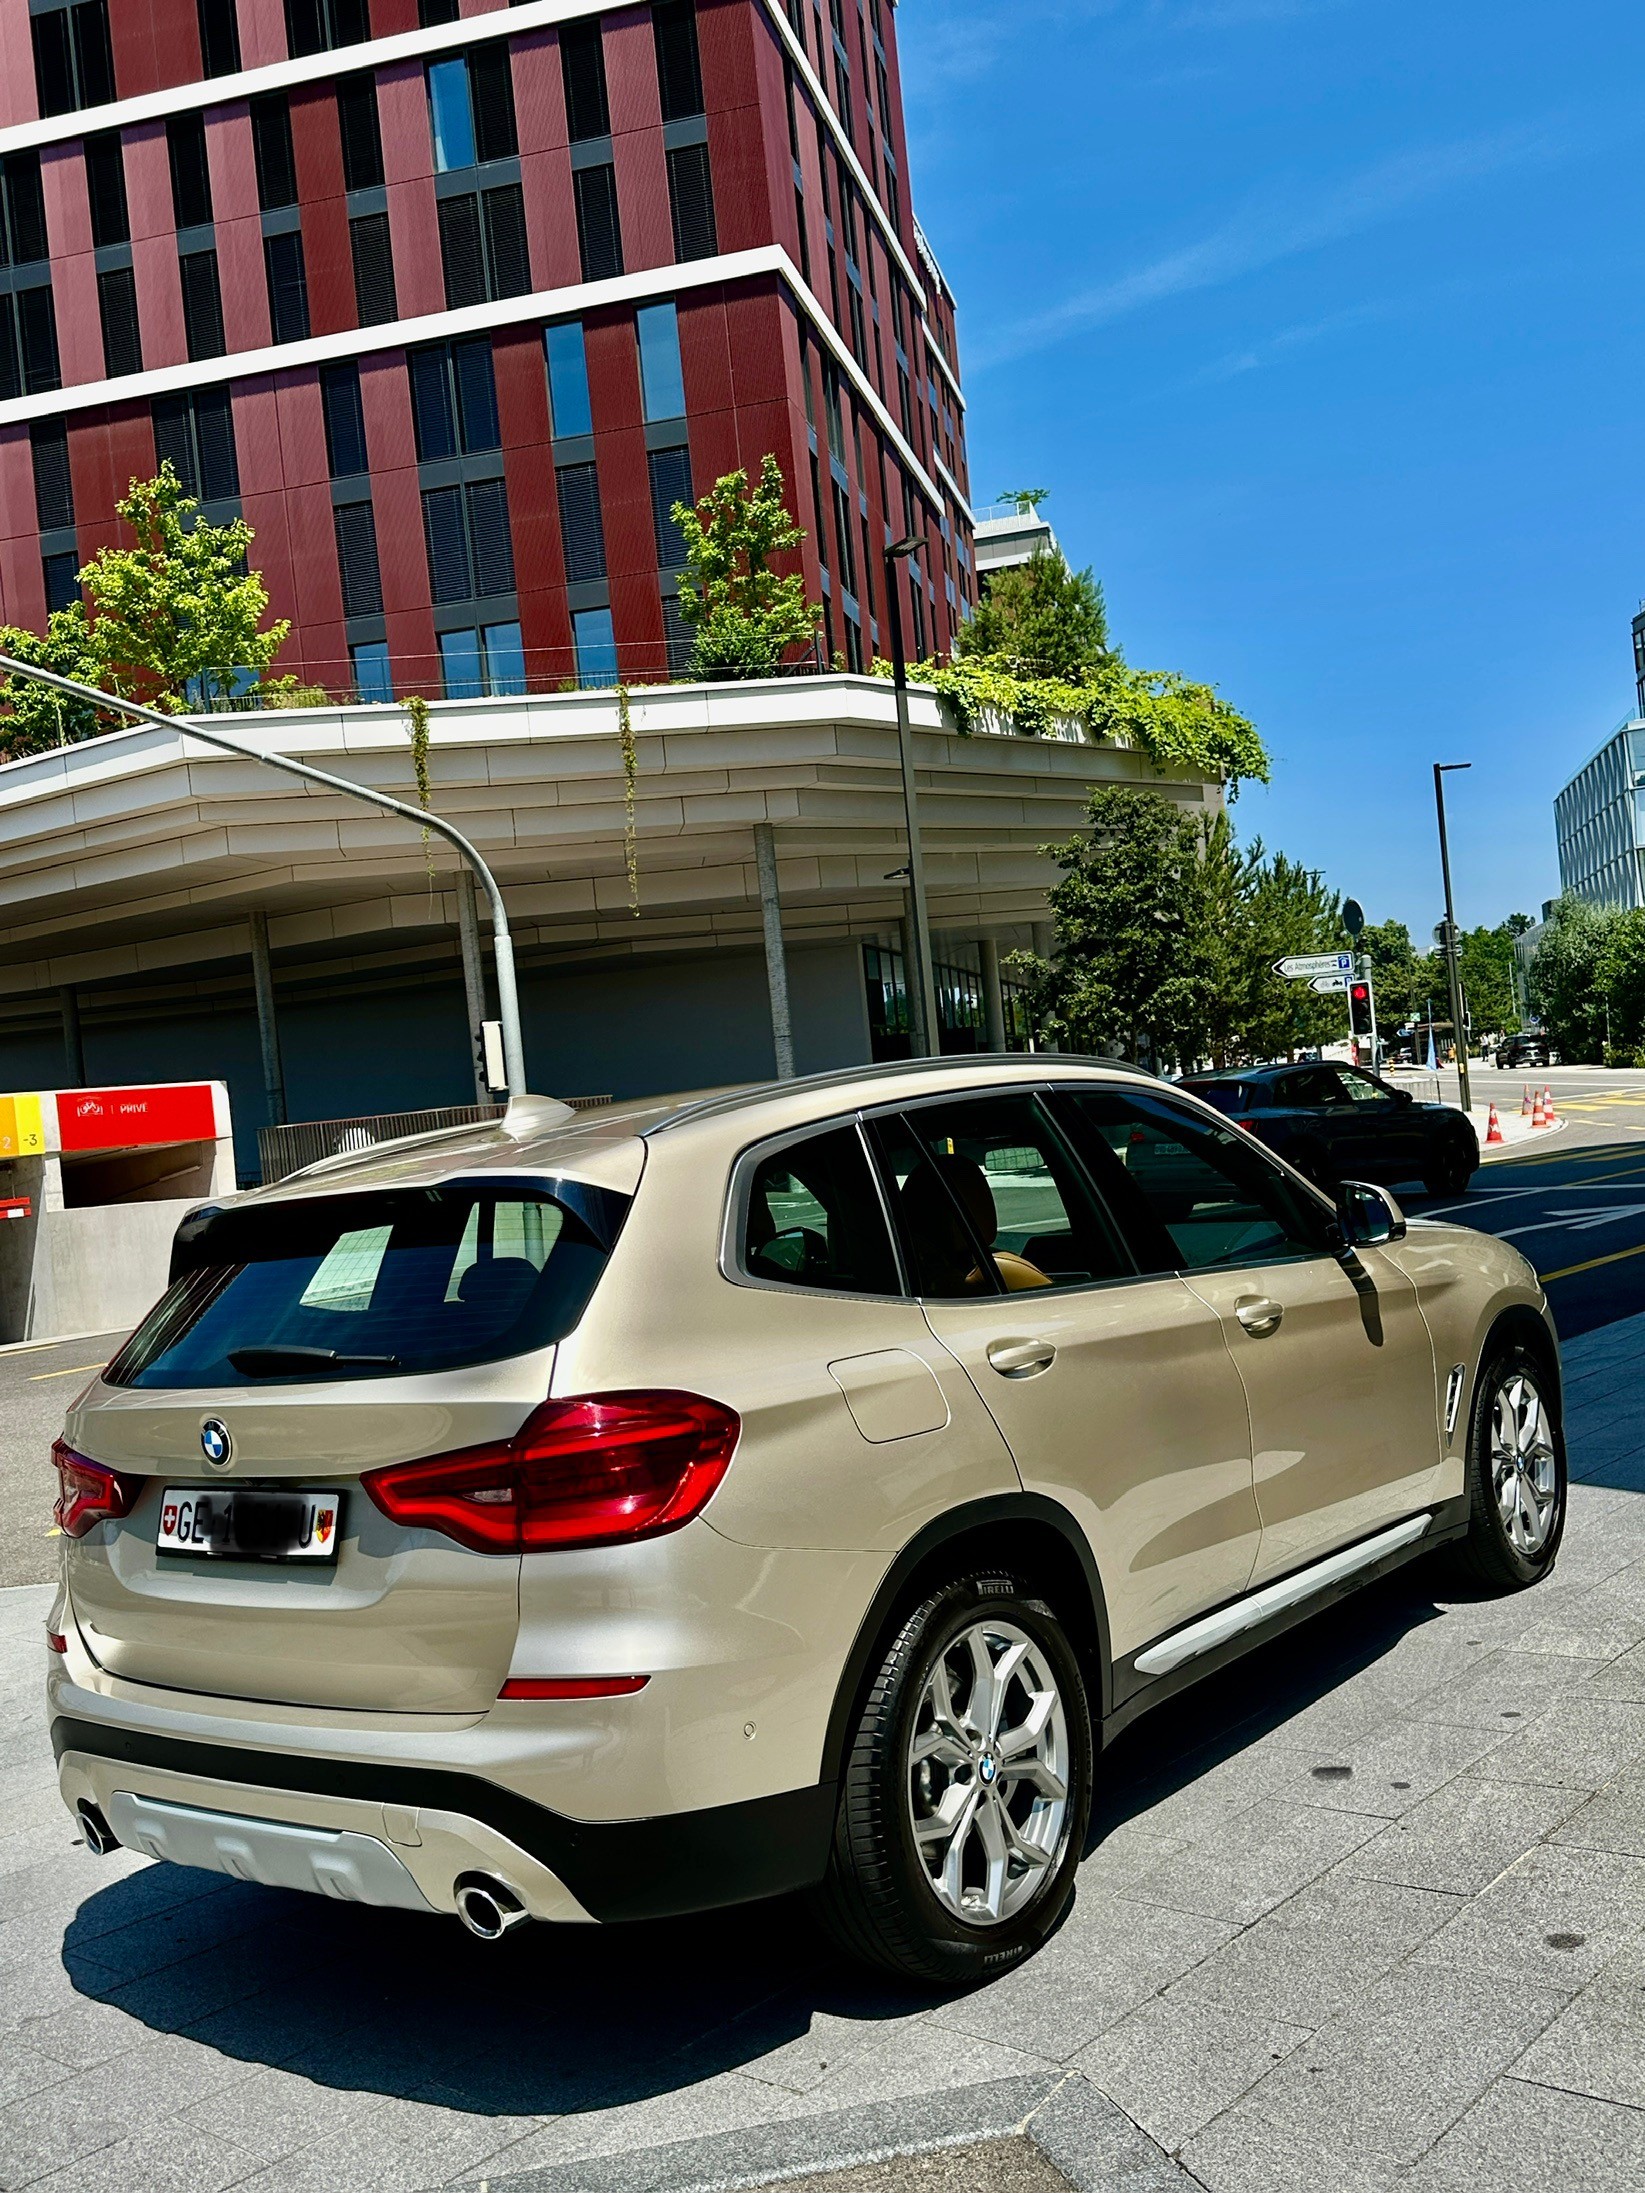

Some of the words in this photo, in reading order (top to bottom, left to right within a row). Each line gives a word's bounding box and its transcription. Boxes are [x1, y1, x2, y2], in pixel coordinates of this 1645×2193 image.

[23, 1133, 38, 1147] -3
[176, 1500, 209, 1544] GE
[976, 1579, 1014, 1596] PIRELLI
